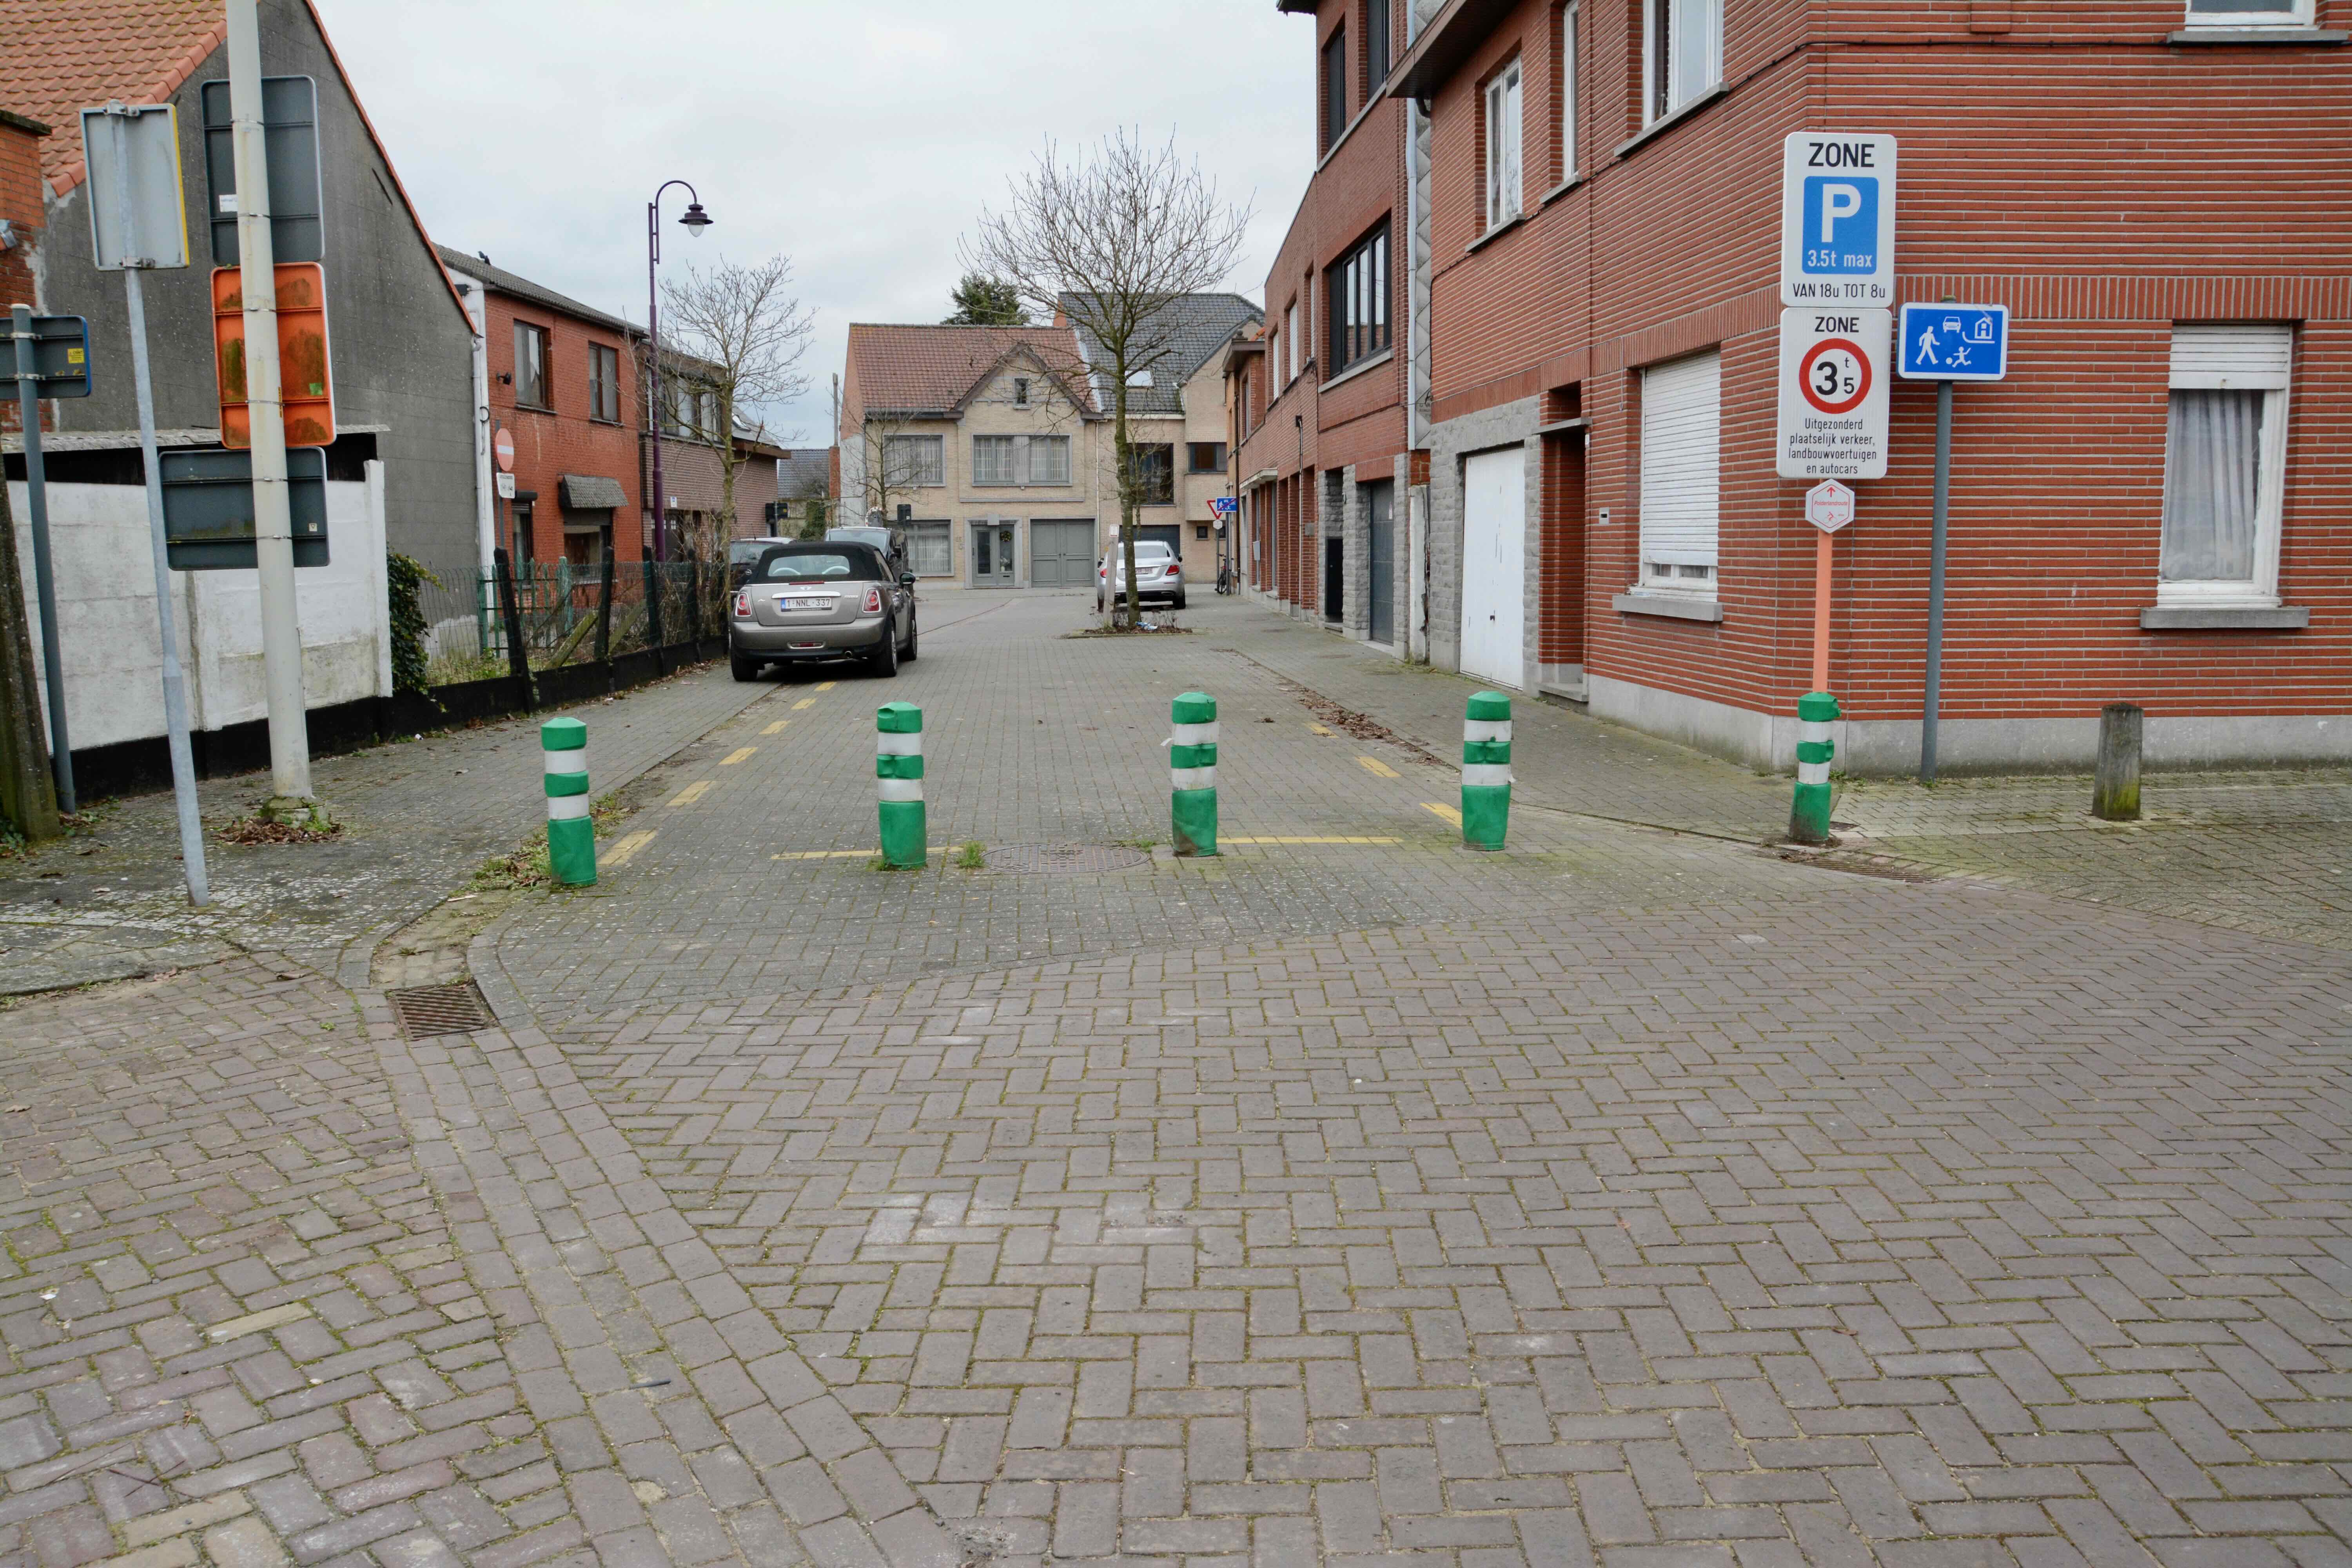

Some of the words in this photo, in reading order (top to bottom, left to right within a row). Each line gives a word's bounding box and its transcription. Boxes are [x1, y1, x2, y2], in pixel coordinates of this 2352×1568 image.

[1808, 142, 1875, 167] ZONE
[1821, 183, 1861, 243] P
[1808, 250, 1837, 267] 3.5t
[1844, 254, 1872, 267] max
[1793, 283, 1815, 297] VAN
[1820, 283, 1839, 298] 18u
[1844, 284, 1866, 298] TOT
[1871, 284, 1885, 298] 8u
[1815, 316, 1859, 333] ZONE
[1804, 418, 1863, 432] Uitgezonderd
[1790, 432, 1836, 447] plaatselijk
[1840, 434, 1875, 446] verkeer,
[1788, 448, 1877, 462] landbouwvoertuigen
[1806, 465, 1817, 474] en
[1820, 463, 1858, 474] autocars
